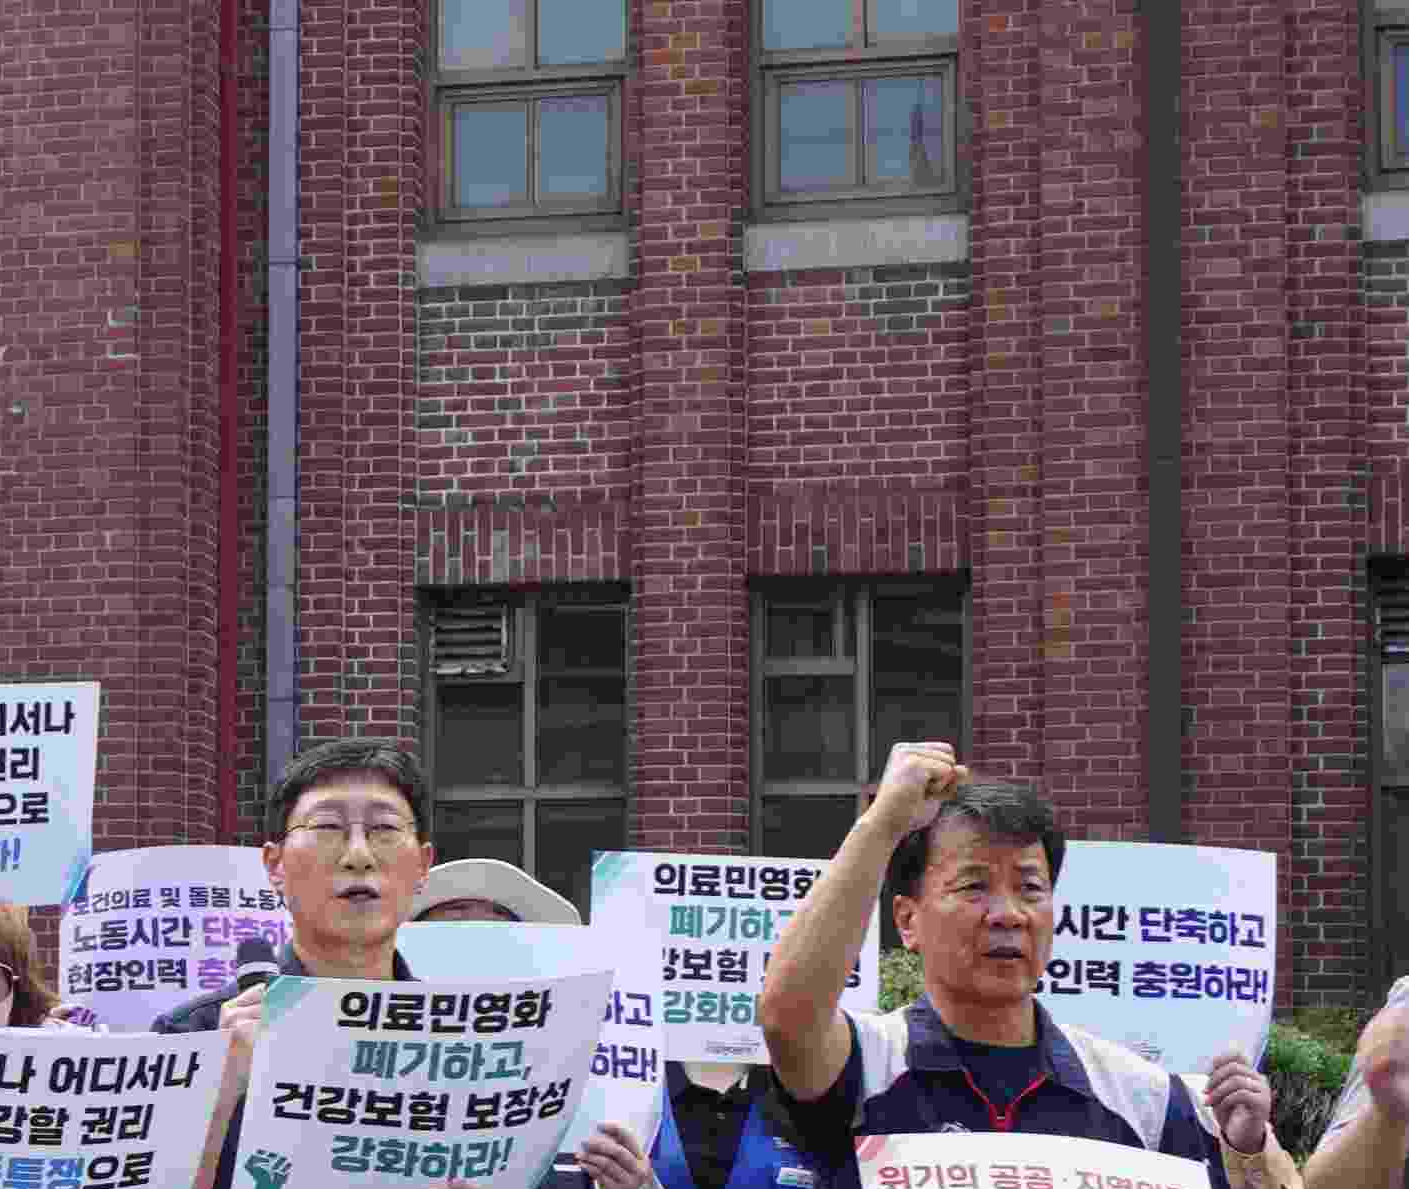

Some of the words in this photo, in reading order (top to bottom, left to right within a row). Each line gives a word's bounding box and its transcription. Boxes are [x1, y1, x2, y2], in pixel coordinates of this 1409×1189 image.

[161, 887, 180, 909] 및
[189, 887, 230, 909] 돌봄
[72, 916, 192, 952] 노동시간
[1139, 906, 1265, 948] 단축하고
[68, 959, 187, 994] 현장인력
[1037, 959, 1120, 996] 인력
[1133, 961, 1268, 1004] 충원하라!
[337, 989, 552, 1034] 의료민영화
[48, 1052, 199, 1097] 어디서나
[351, 1040, 531, 1083] 폐기하고,
[80, 1103, 154, 1144] 권리
[272, 1082, 447, 1131] 건강보험
[462, 1078, 572, 1131] 보장성
[330, 1135, 513, 1179] 강화하라!
